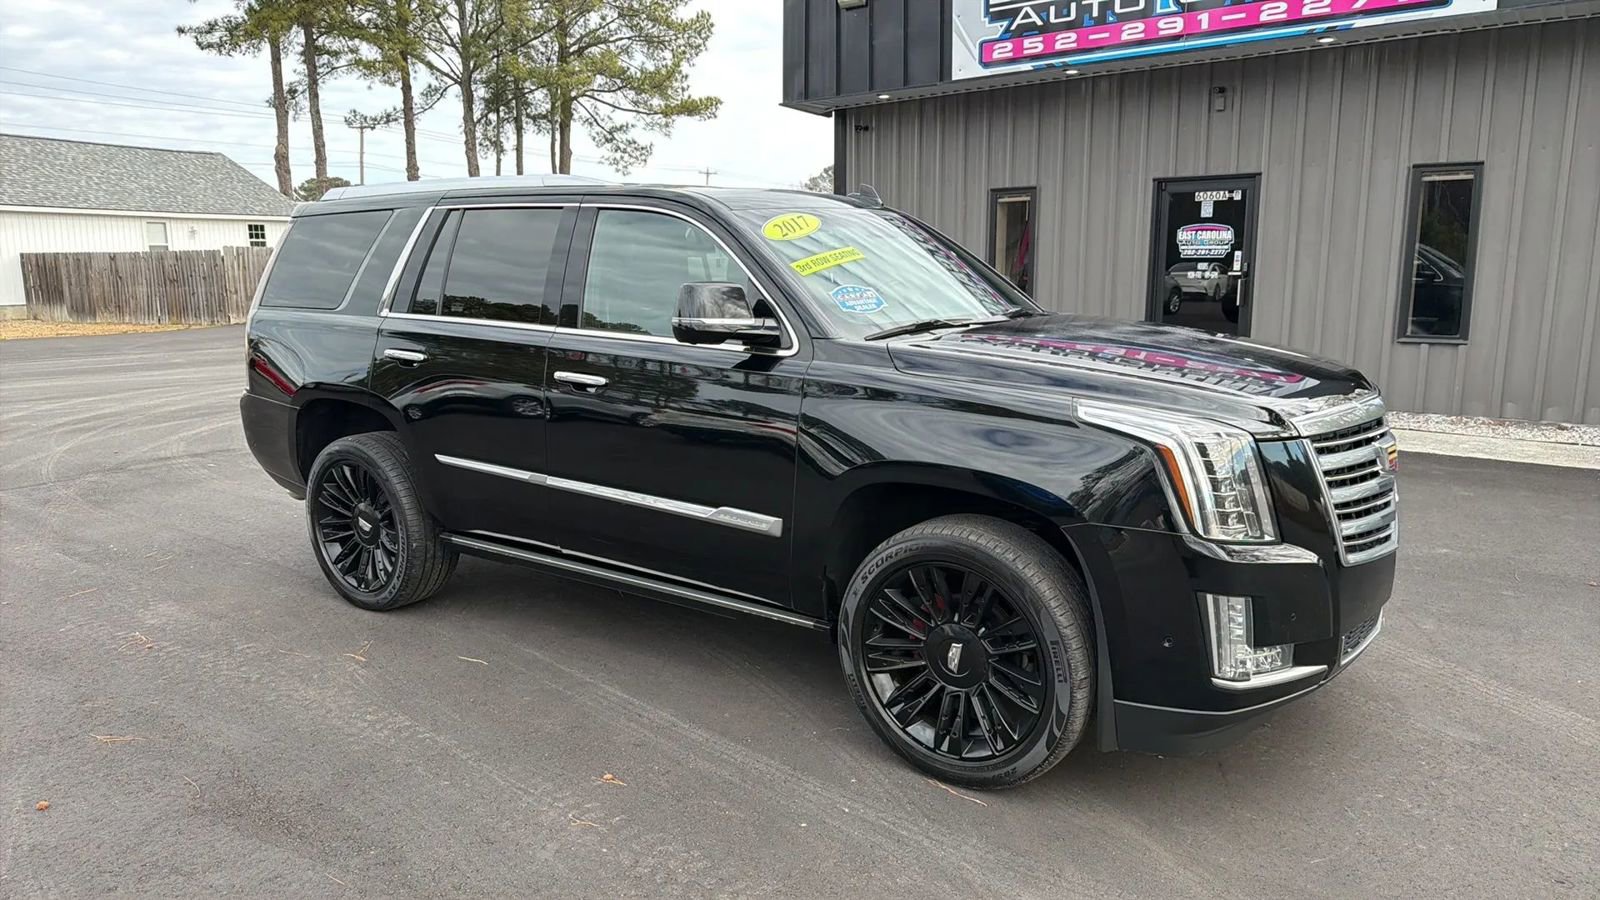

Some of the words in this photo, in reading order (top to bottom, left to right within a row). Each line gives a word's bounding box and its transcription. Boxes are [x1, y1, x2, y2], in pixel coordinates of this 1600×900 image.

[1010, 0, 1145, 30] AUTO
[991, 0, 1408, 59] 252-291-22
[773, 215, 809, 237] 2017
[1179, 230, 1196, 240] EAST
[1197, 230, 1232, 241] CAROLINA
[796, 262, 812, 272] 3rd
[811, 256, 831, 267] ROW
[829, 249, 860, 261] SEATING
